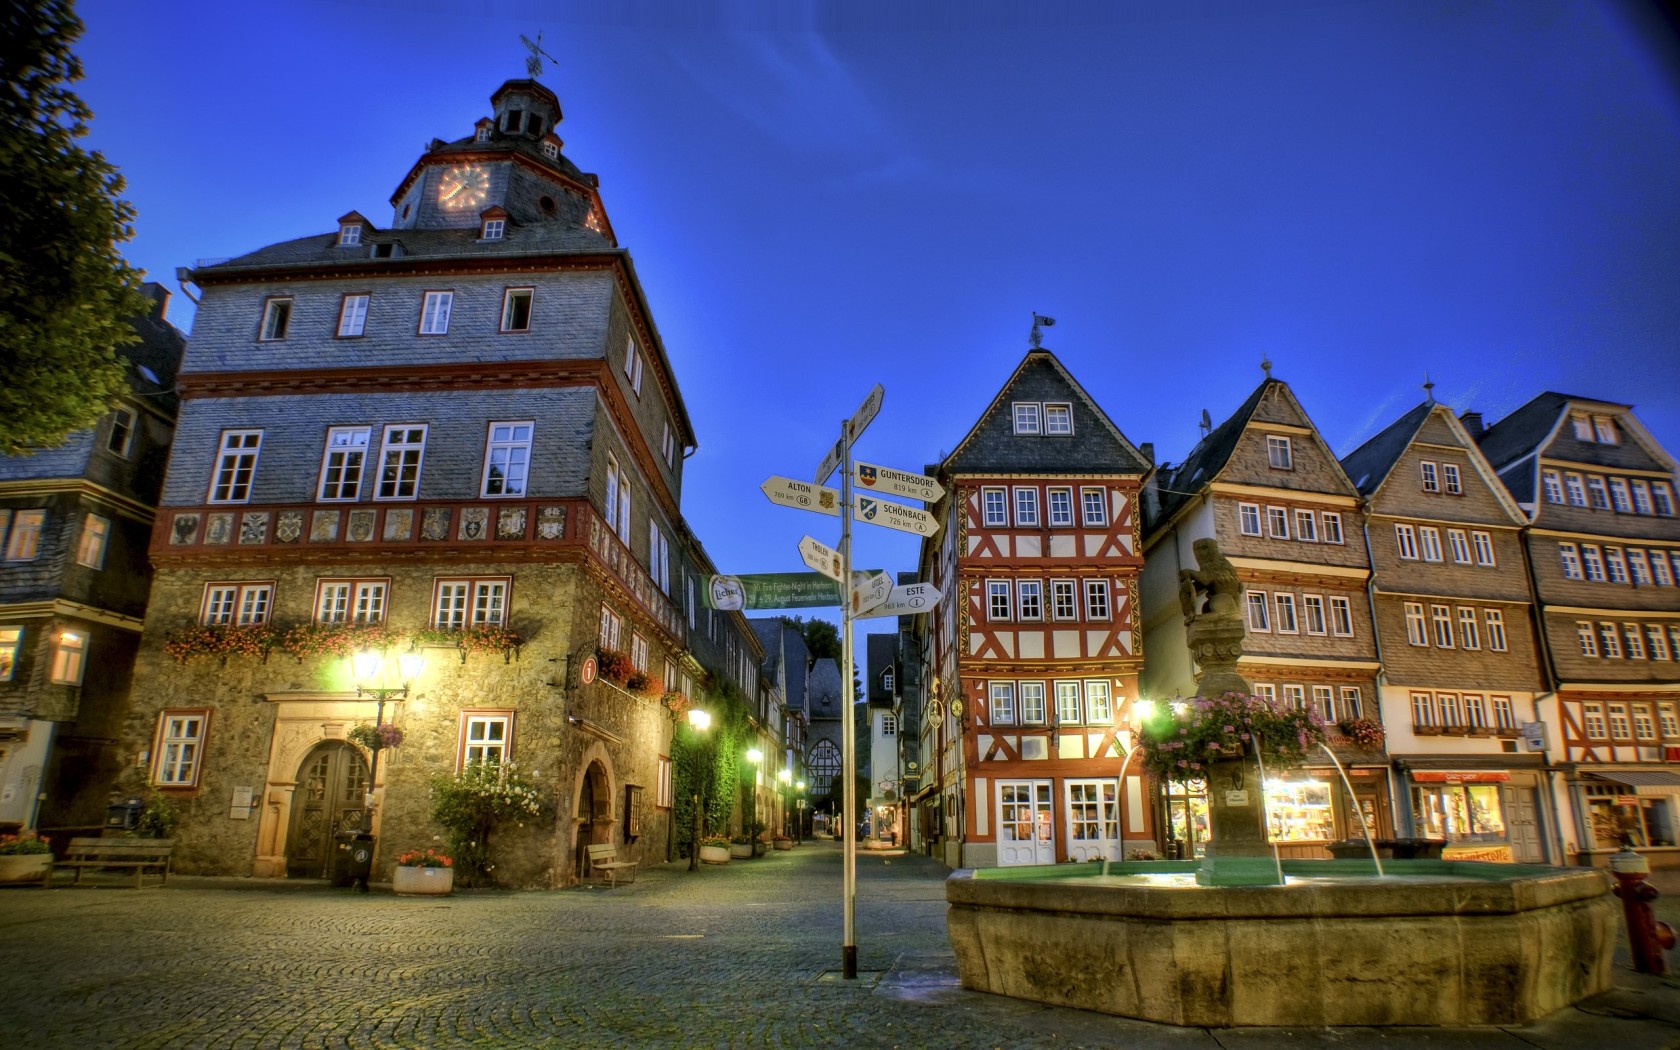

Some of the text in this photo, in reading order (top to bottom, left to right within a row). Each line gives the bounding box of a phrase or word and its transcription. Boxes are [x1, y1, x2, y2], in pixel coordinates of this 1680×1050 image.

[881, 470, 934, 488] GUNTERSDORF
[788, 482, 811, 493] ALTON
[894, 484, 905, 492] 819
[908, 485, 917, 494] km
[884, 505, 926, 522] SCHÖNBACH
[890, 517, 900, 525] 726
[903, 520, 911, 528] km
[812, 542, 828, 556] THOLEN
[715, 588, 738, 600] Licher
[906, 586, 924, 596] ESTE
